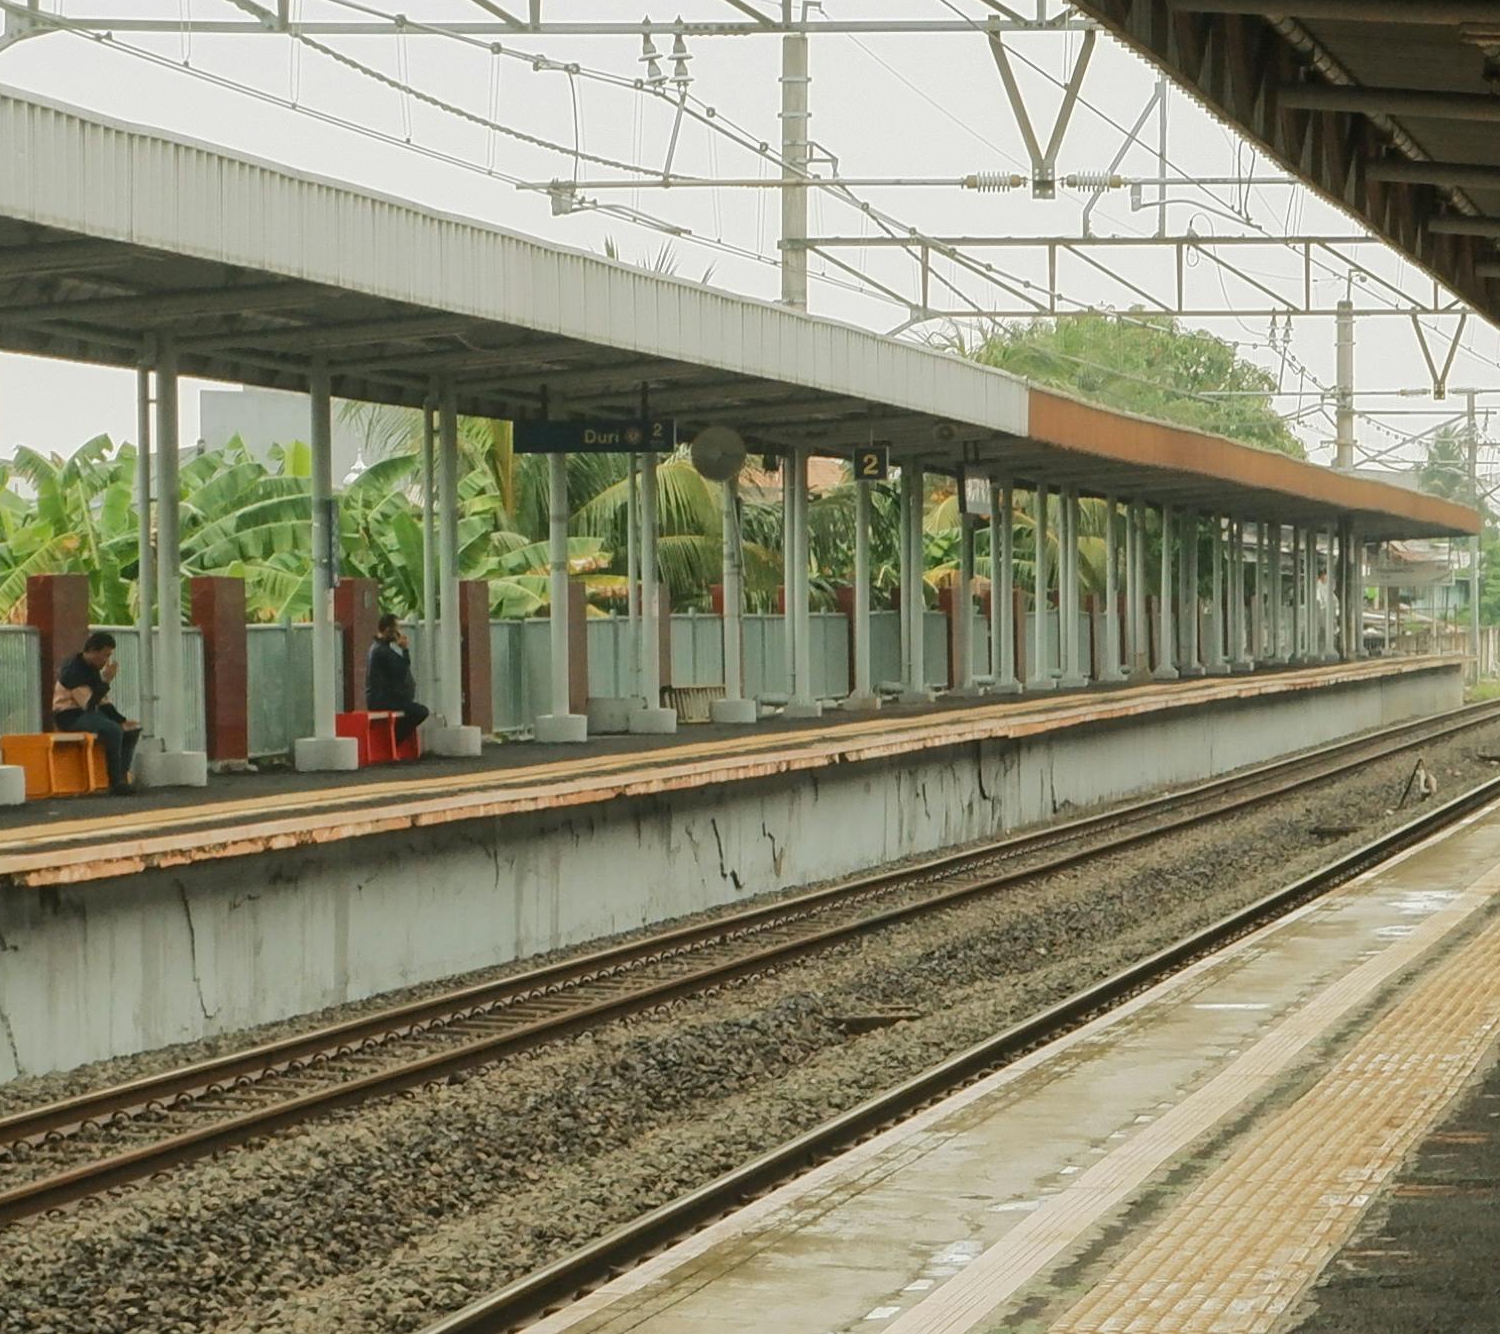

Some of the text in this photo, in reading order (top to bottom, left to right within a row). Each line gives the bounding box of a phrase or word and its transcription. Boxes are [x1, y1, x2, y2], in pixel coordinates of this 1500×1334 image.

[584, 429, 620, 444] Duri
[652, 422, 663, 437] 2
[863, 453, 878, 475] 2
